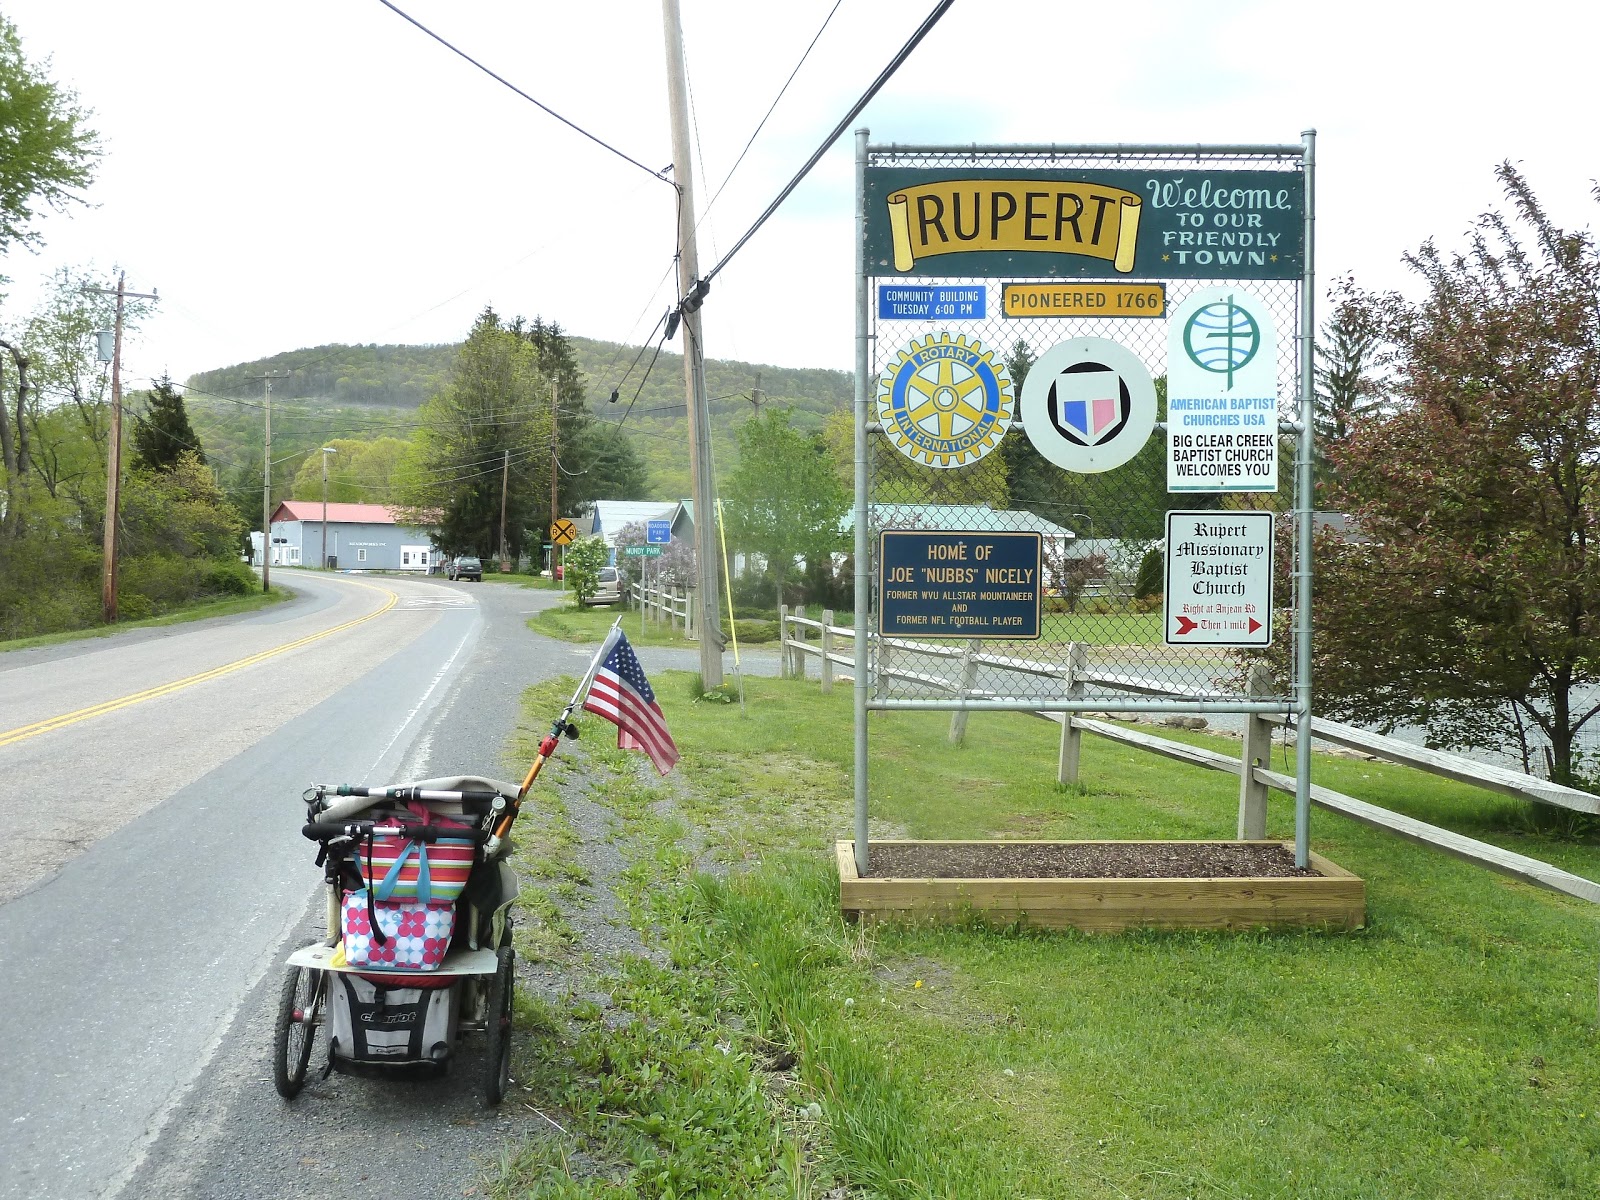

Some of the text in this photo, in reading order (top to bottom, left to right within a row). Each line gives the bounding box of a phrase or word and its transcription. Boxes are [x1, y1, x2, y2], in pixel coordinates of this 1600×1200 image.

[1146, 177, 1292, 210] Welcome
[917, 191, 1117, 247] RUPERT
[1176, 213, 1264, 228] TO OUR
[1162, 231, 1281, 247] FRIENDLY
[1173, 250, 1266, 266] TOWN
[886, 291, 979, 302] COMMUNITY BUILDING
[1010, 293, 1158, 308] PIONEERED 1766
[893, 303, 972, 315] TUESDAY 6:00 PM
[919, 346, 974, 362] ROTARY
[1170, 398, 1275, 411] AMERICAN BAPTIST
[1183, 414, 1266, 426] CHURCHES USA
[898, 415, 993, 452] INTERNATIONAL
[1173, 434, 1274, 447] BIG CLEAR CREEK
[1173, 449, 1273, 461] BAPTIST CHURCH
[1176, 463, 1270, 476] WELCOMES YOU
[1193, 522, 1247, 539] Rupert
[625, 547, 661, 555] MUNDY PARK
[928, 545, 993, 561] HOME OF
[1175, 541, 1264, 559] Missionary
[887, 567, 1033, 584] JOE "NUBBS" NICELY
[1190, 561, 1248, 578] Baptist
[887, 590, 1033, 601] FORMER WVU ALLSTAR MOUNTAINEER
[1192, 580, 1245, 596] Church
[952, 604, 968, 612] AND
[1182, 603, 1256, 615] Right at Anjean Rd
[896, 615, 1023, 626] FORMER NFL FOOTBALL PLAYER
[1201, 620, 1221, 631] Then
[1230, 620, 1247, 630] mile
